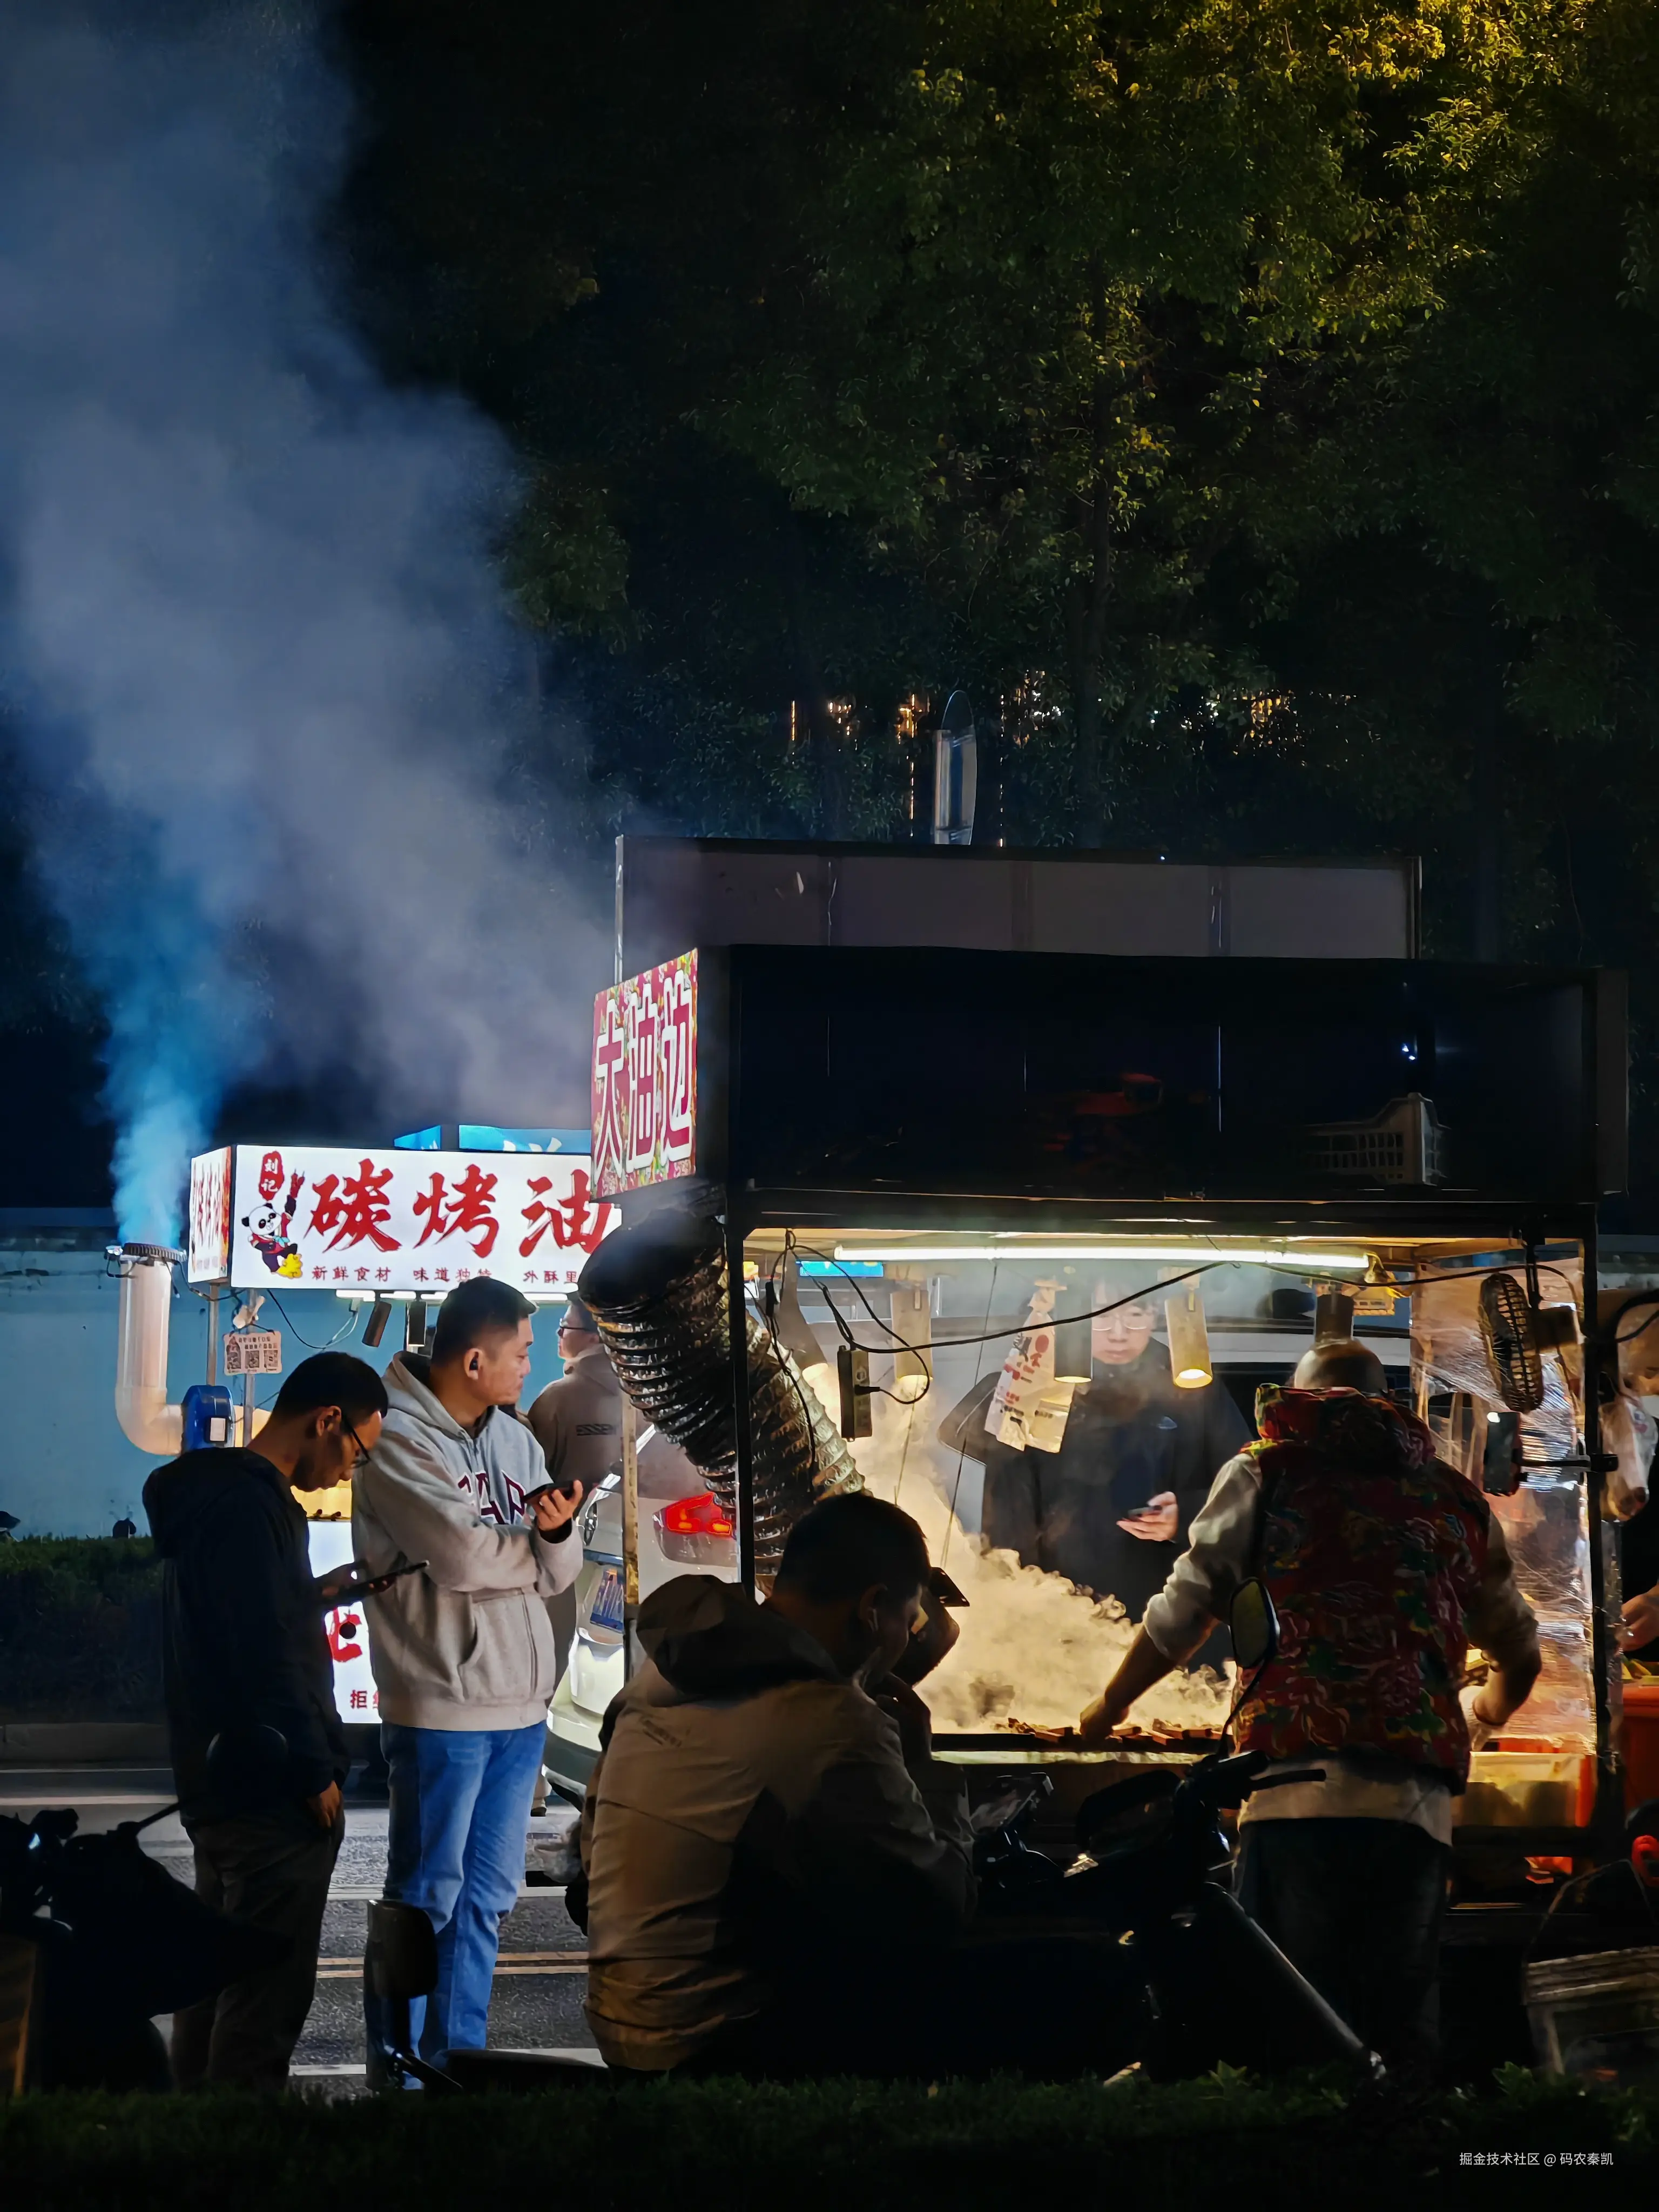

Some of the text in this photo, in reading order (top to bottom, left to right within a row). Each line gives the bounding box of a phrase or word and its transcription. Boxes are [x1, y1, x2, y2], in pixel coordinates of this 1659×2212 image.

[594, 970, 692, 1185] 大油边
[261, 1158, 279, 1192] 刘记
[304, 1158, 613, 1258] 碳烤油
[312, 1265, 391, 1282] 新鲜食材
